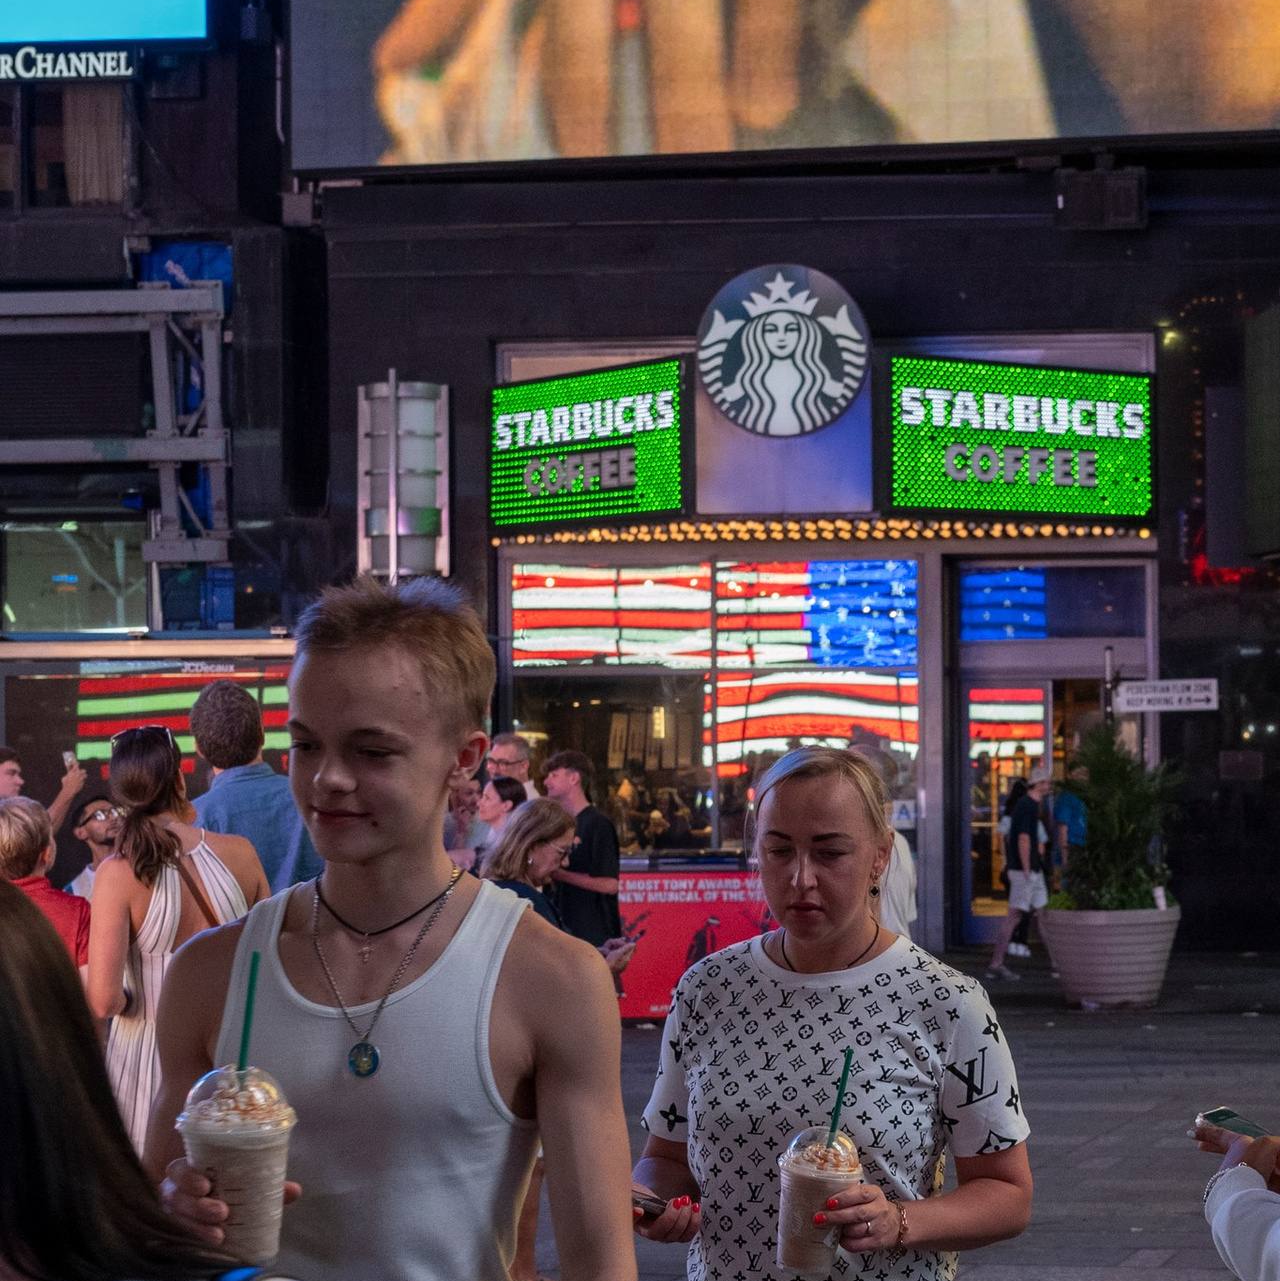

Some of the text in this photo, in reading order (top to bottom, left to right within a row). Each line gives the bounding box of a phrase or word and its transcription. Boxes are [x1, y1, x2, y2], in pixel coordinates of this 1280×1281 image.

[495, 390, 675, 450] STARBUCKS
[900, 386, 1146, 440] STARBUCKS
[523, 447, 637, 496] COFFEE
[944, 442, 1098, 488] COFFEE
[626, 879, 661, 890] MOST
[663, 879, 695, 890] TONY
[647, 891, 701, 902] MUSICAL
[703, 891, 719, 902] OF
[722, 891, 746, 901] THE
